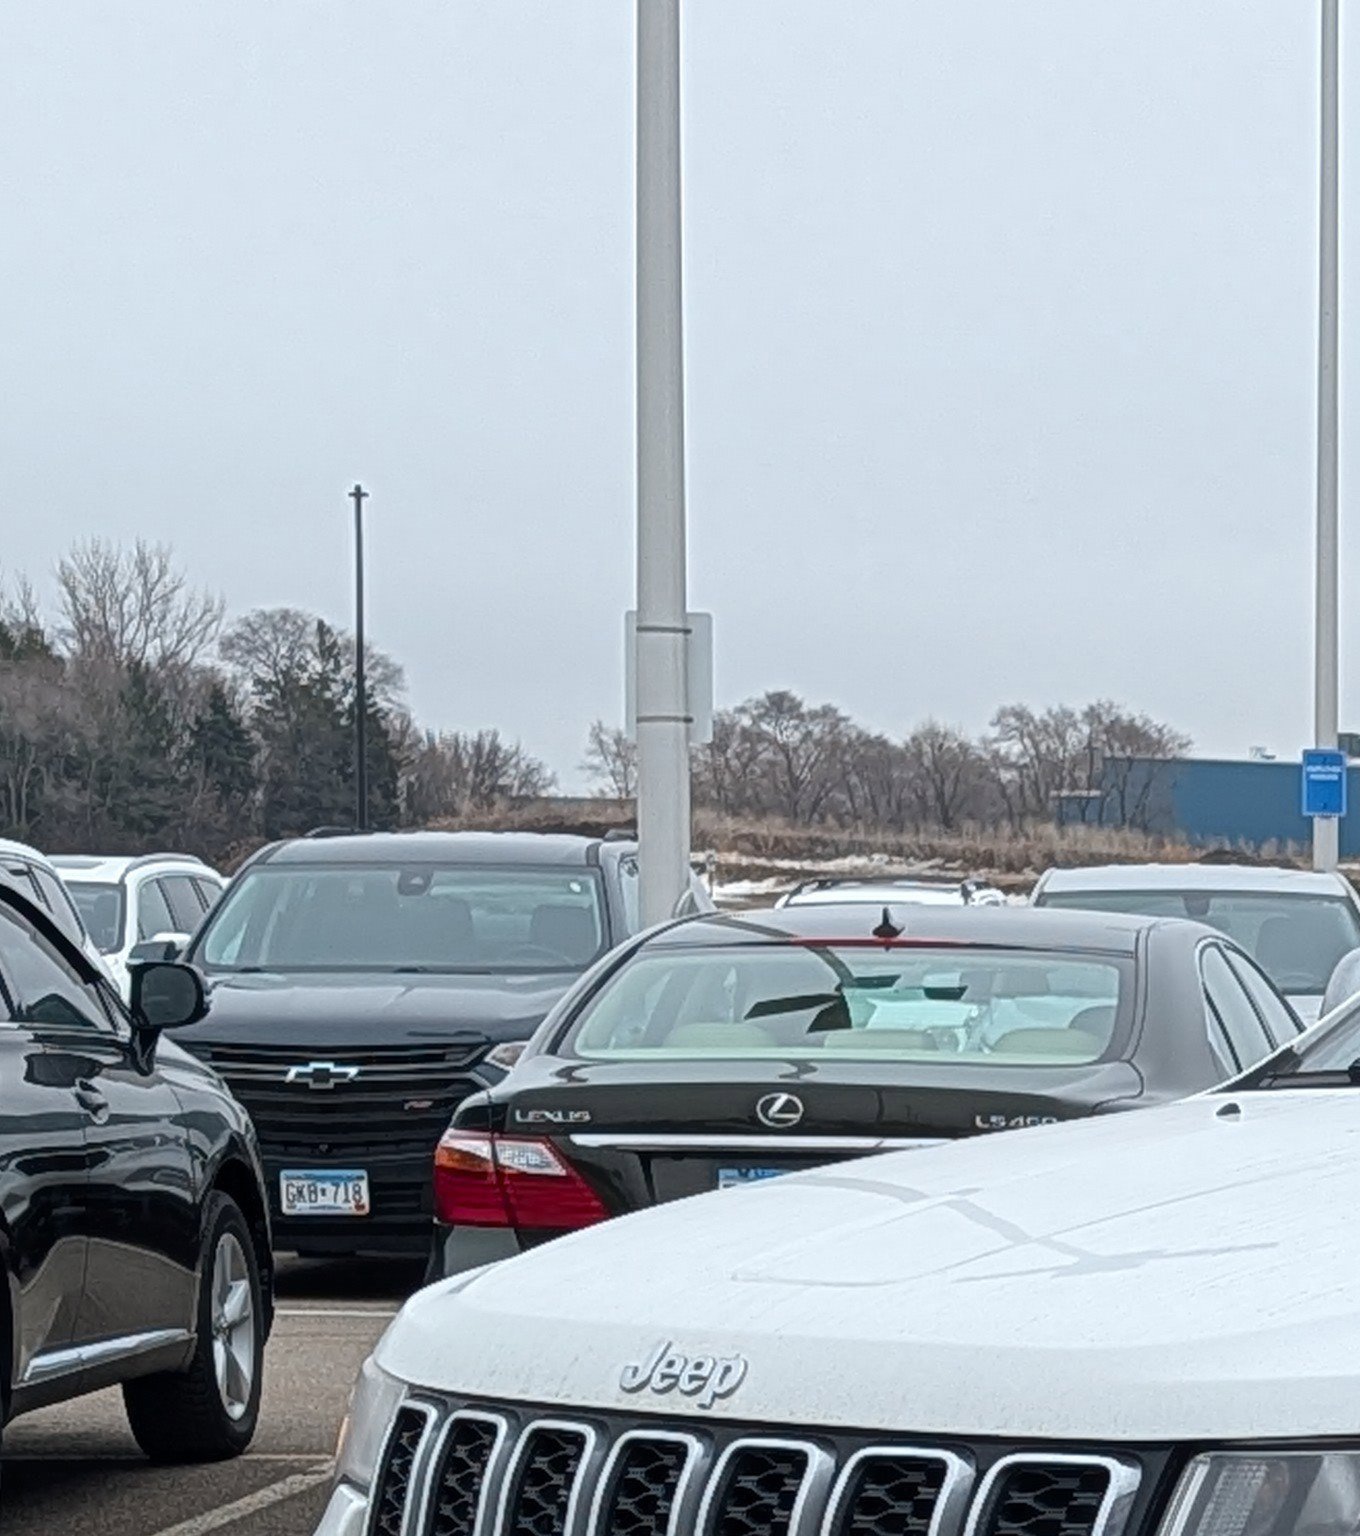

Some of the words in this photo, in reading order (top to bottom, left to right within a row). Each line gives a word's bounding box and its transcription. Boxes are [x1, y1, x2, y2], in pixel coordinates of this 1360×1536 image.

[515, 1109, 591, 1123] LEXUS
[331, 1182, 363, 1203] 718
[619, 1340, 749, 1410] Jeep
